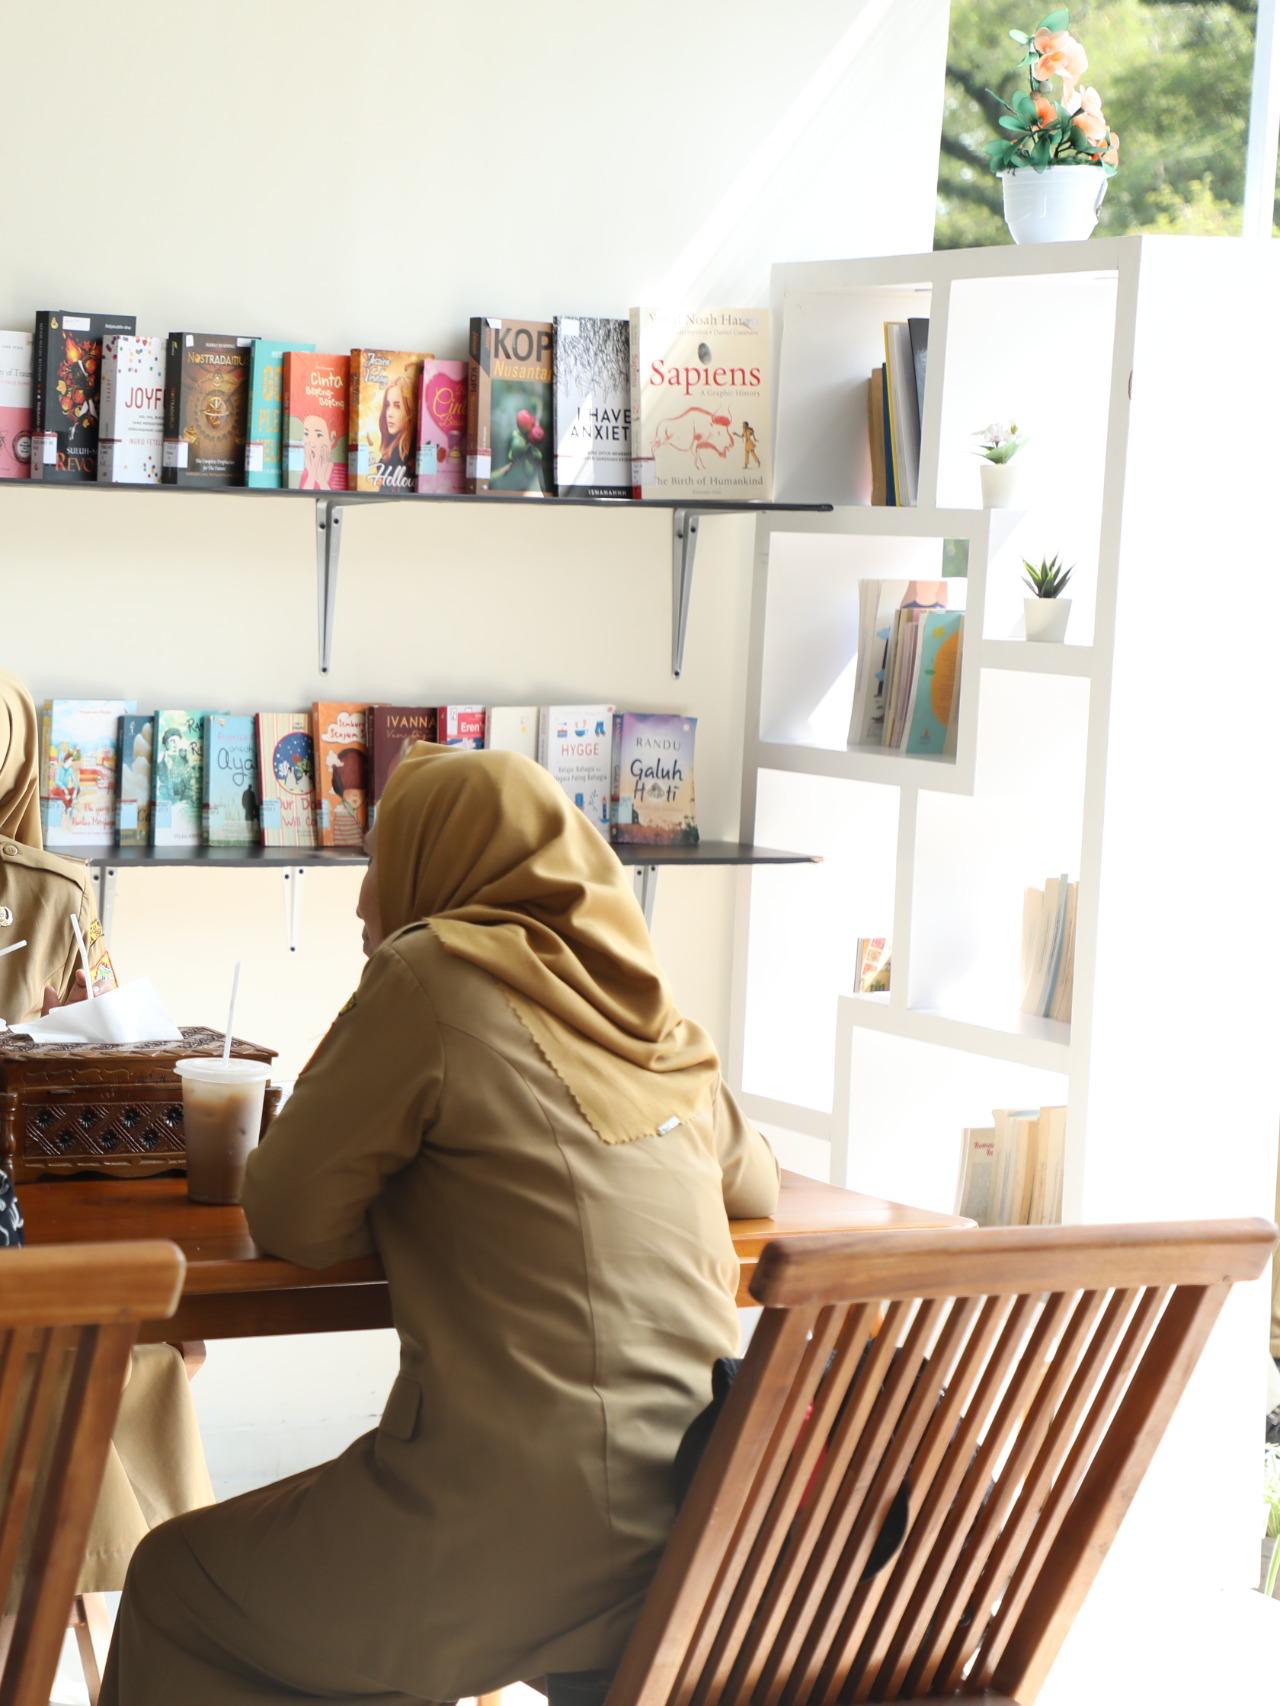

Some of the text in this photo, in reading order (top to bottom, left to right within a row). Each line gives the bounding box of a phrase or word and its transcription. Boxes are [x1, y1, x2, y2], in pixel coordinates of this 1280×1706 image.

[494, 328, 553, 362] KOP
[649, 359, 761, 396] Sapiens
[671, 477, 694, 486] Birth
[697, 476, 707, 486] of
[710, 476, 764, 486] Humankind
[561, 742, 599, 756] HYGGE
[636, 736, 681, 751] RANDU
[631, 757, 683, 782] Galuh
[633, 780, 679, 803] Hti
